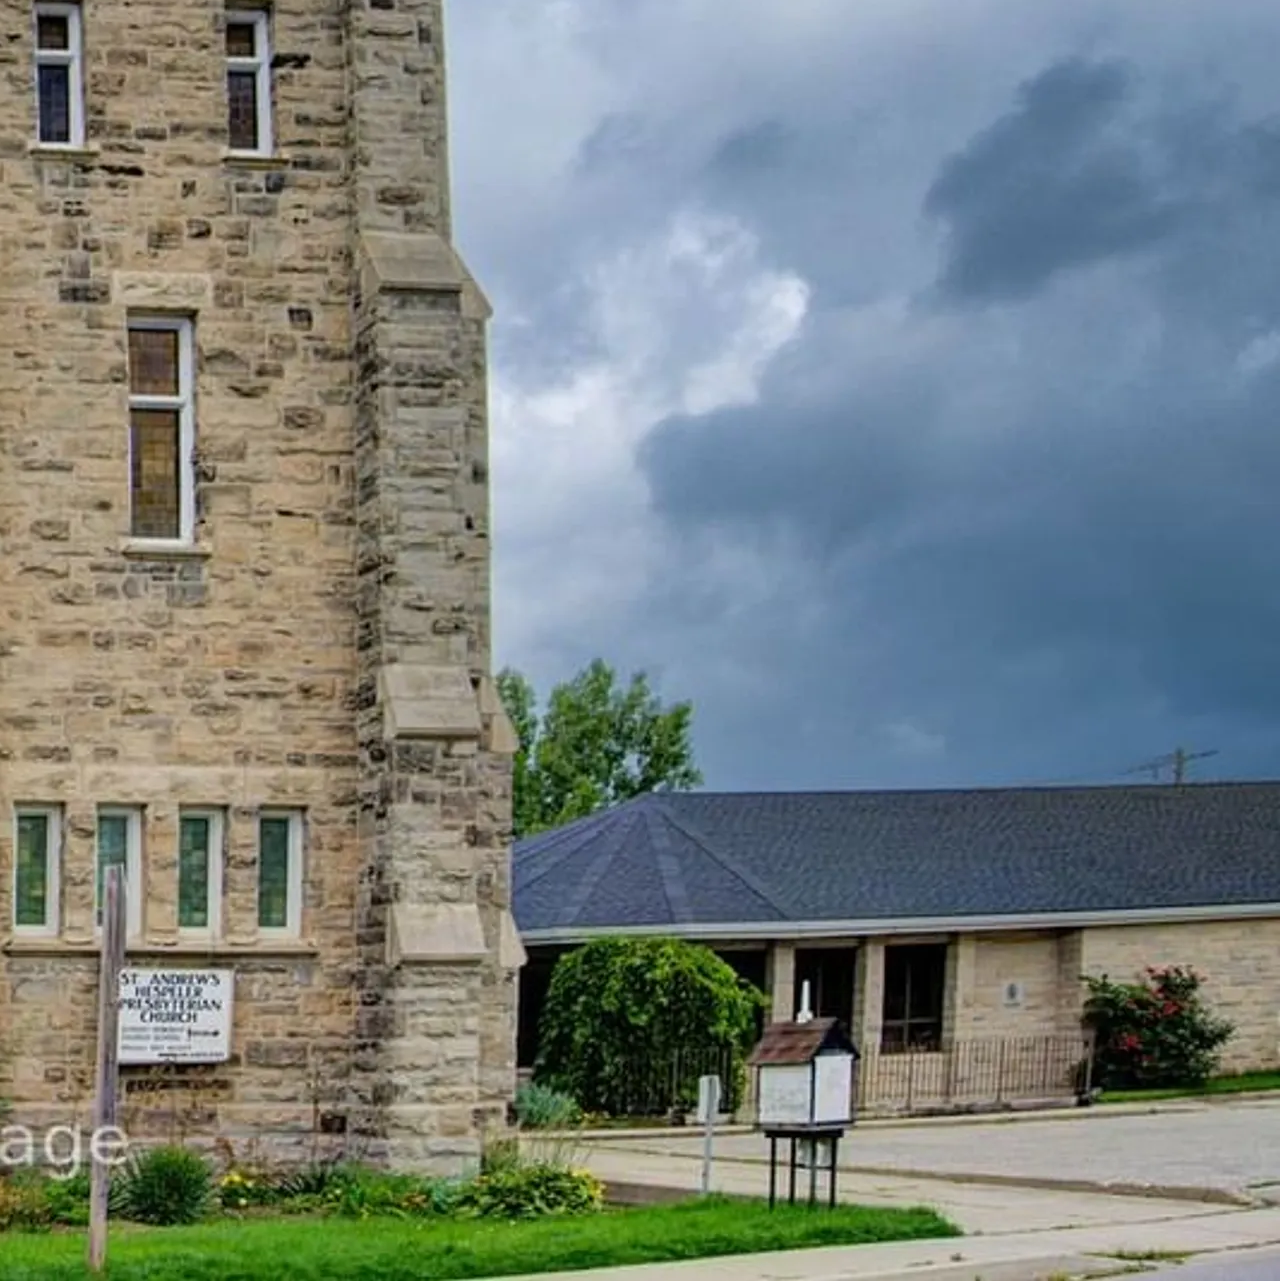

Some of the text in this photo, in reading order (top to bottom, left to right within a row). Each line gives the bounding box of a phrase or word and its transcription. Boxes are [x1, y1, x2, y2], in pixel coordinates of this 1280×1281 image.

[120, 973, 137, 985] ST
[135, 986, 203, 997] HESPELER
[119, 998, 222, 1010] PRESBYTERIAN
[140, 1010, 198, 1023] CHURCH
